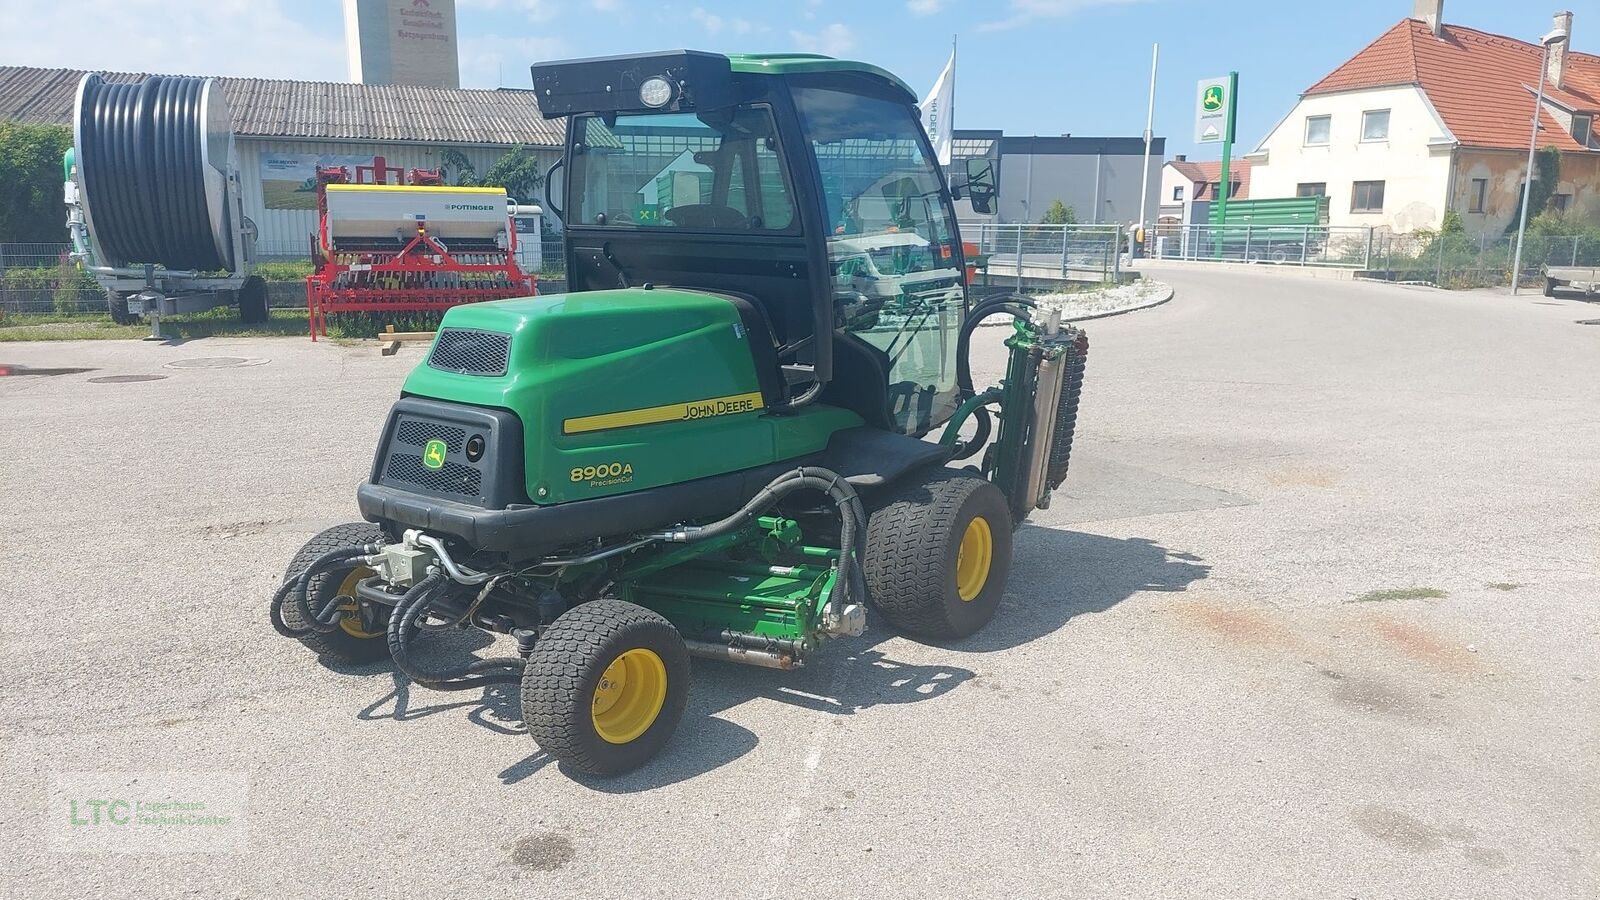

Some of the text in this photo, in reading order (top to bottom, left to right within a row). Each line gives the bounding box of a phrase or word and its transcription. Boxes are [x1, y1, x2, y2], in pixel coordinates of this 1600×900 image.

[683, 399, 754, 419] JOHN DEERE
[590, 475, 633, 487] PrecisionCut
